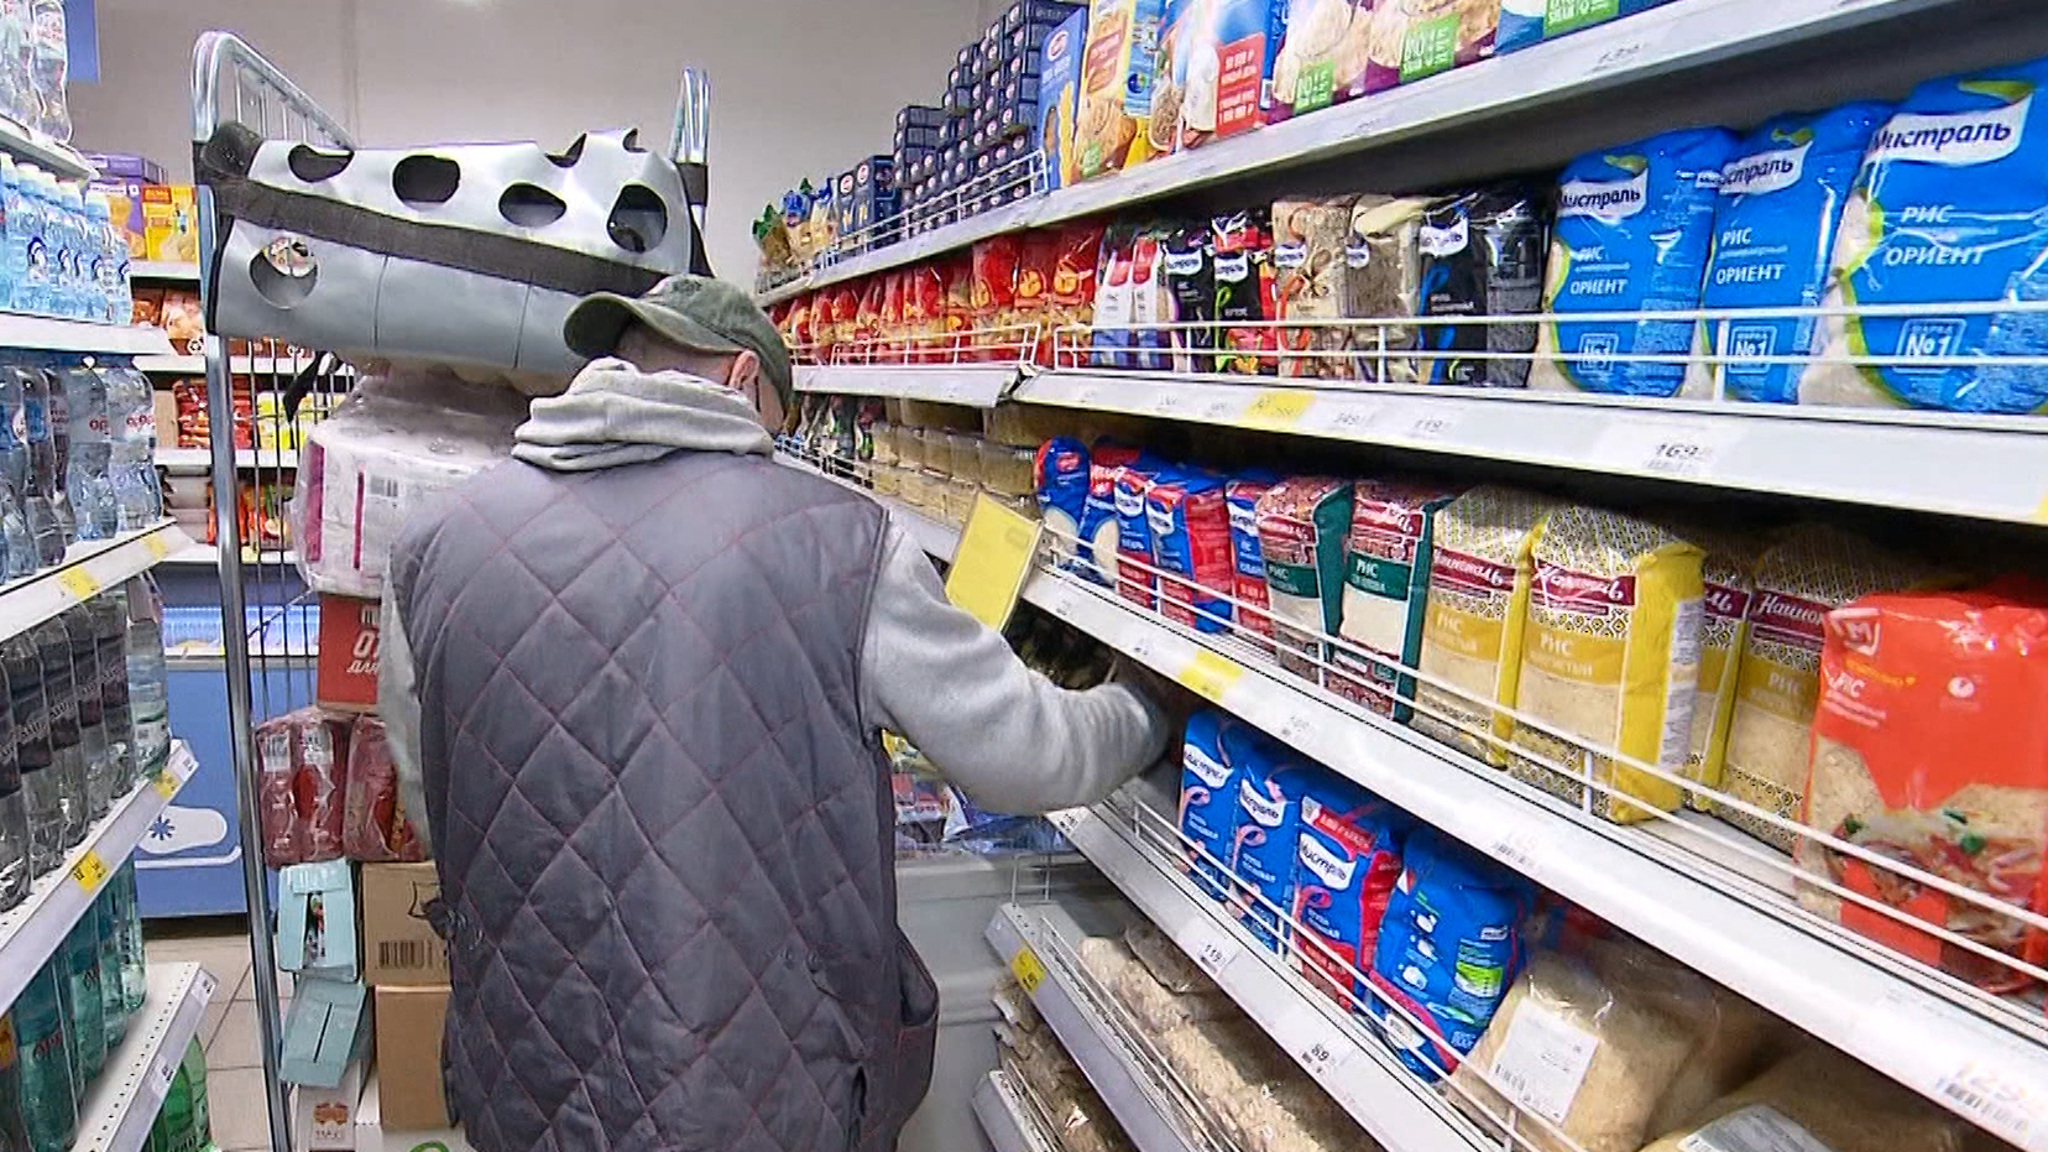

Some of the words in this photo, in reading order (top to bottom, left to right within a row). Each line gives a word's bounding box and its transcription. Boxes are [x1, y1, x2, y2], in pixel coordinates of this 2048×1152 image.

[1874, 122, 2012, 151] Мистраль
[1722, 159, 1793, 185] страль
[1901, 204, 1954, 223] РИС
[1721, 227, 1753, 247] РИС
[1883, 246, 1985, 266] ОРИЕНТ
[1716, 263, 1785, 285] ОРИЕНТ
[1570, 279, 1628, 295] ОРИЕНТ
